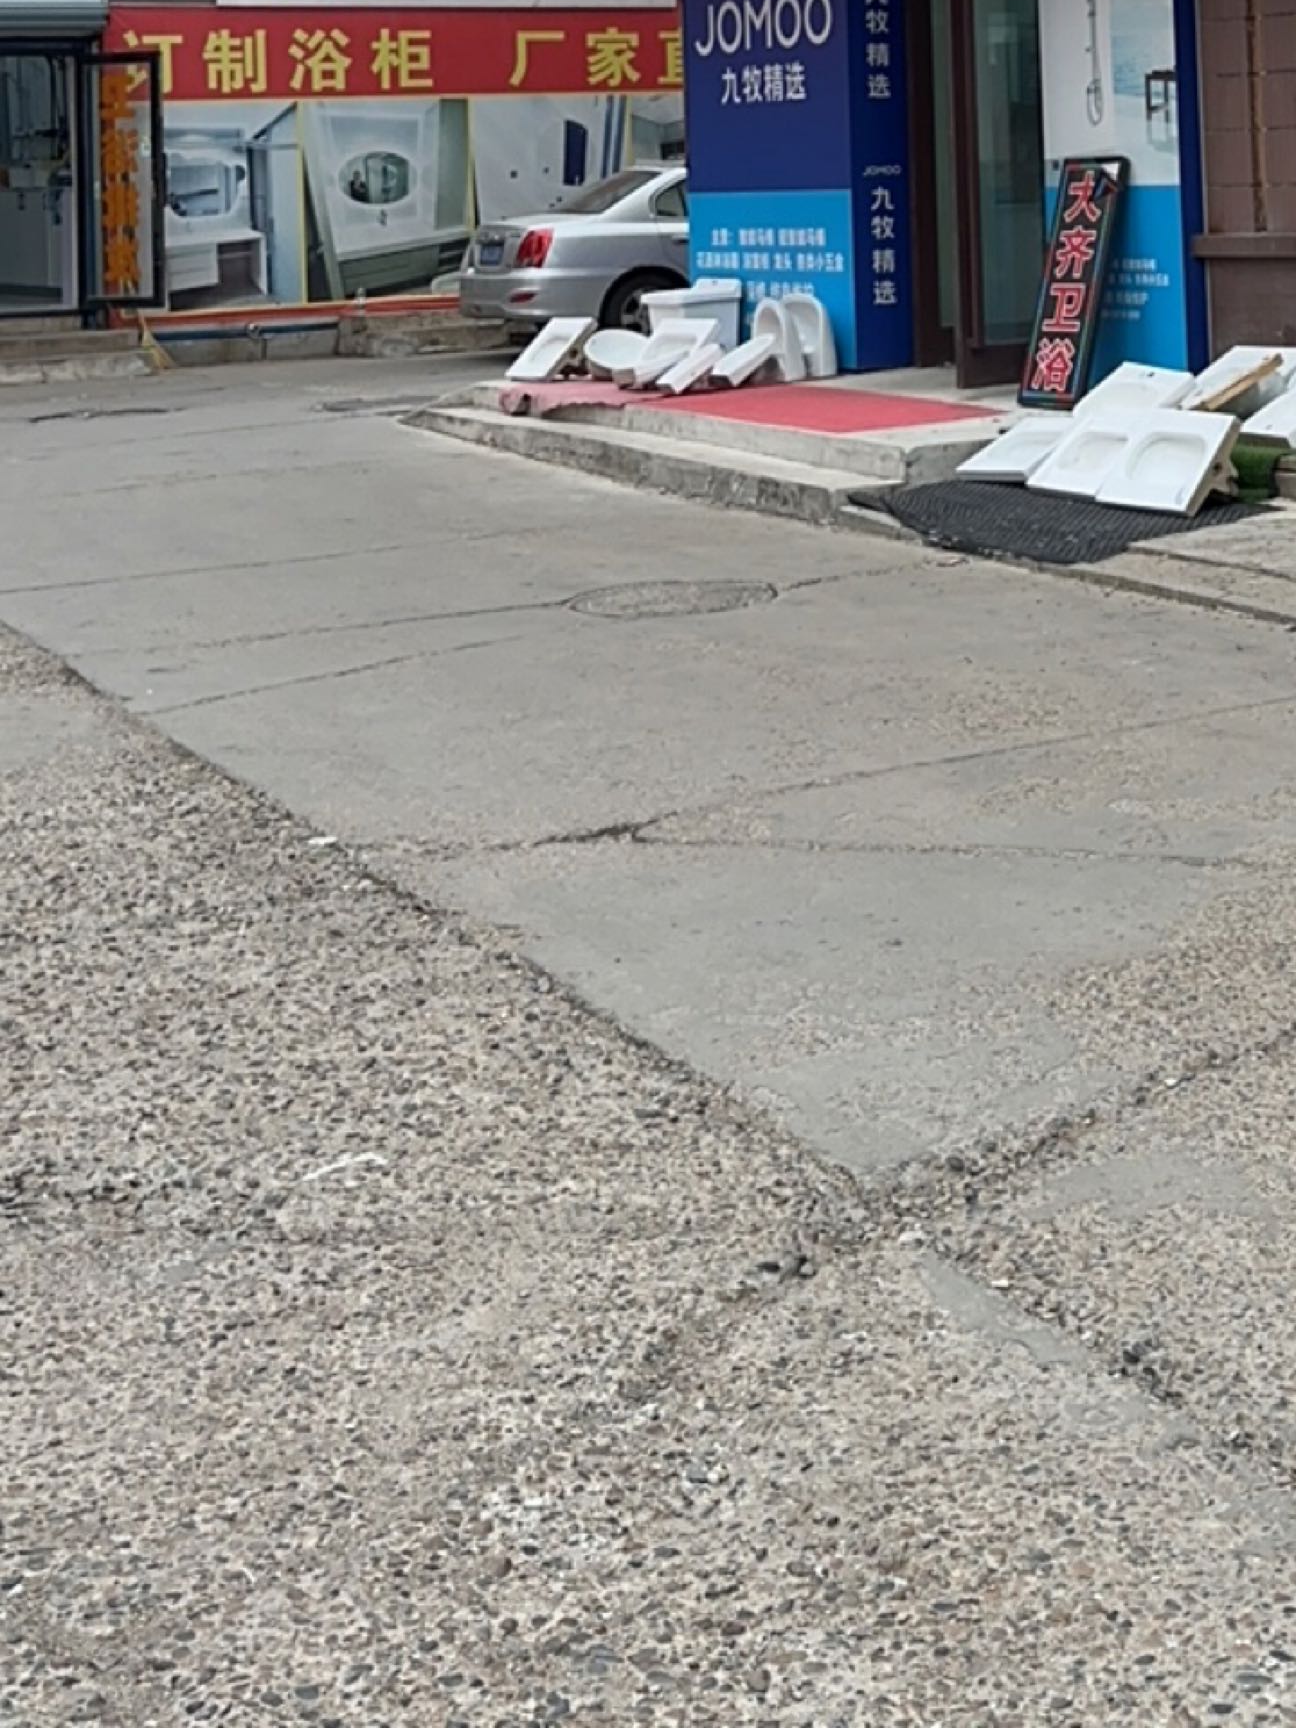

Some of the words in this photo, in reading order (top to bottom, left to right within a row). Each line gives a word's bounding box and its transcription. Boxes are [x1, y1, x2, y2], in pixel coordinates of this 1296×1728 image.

[123, 28, 433, 93] 订制浴柜
[721, 60, 806, 104] 九牧精选
[871, 186, 897, 305] 九牧精选
[1031, 171, 1101, 392] 大齐卫浴
